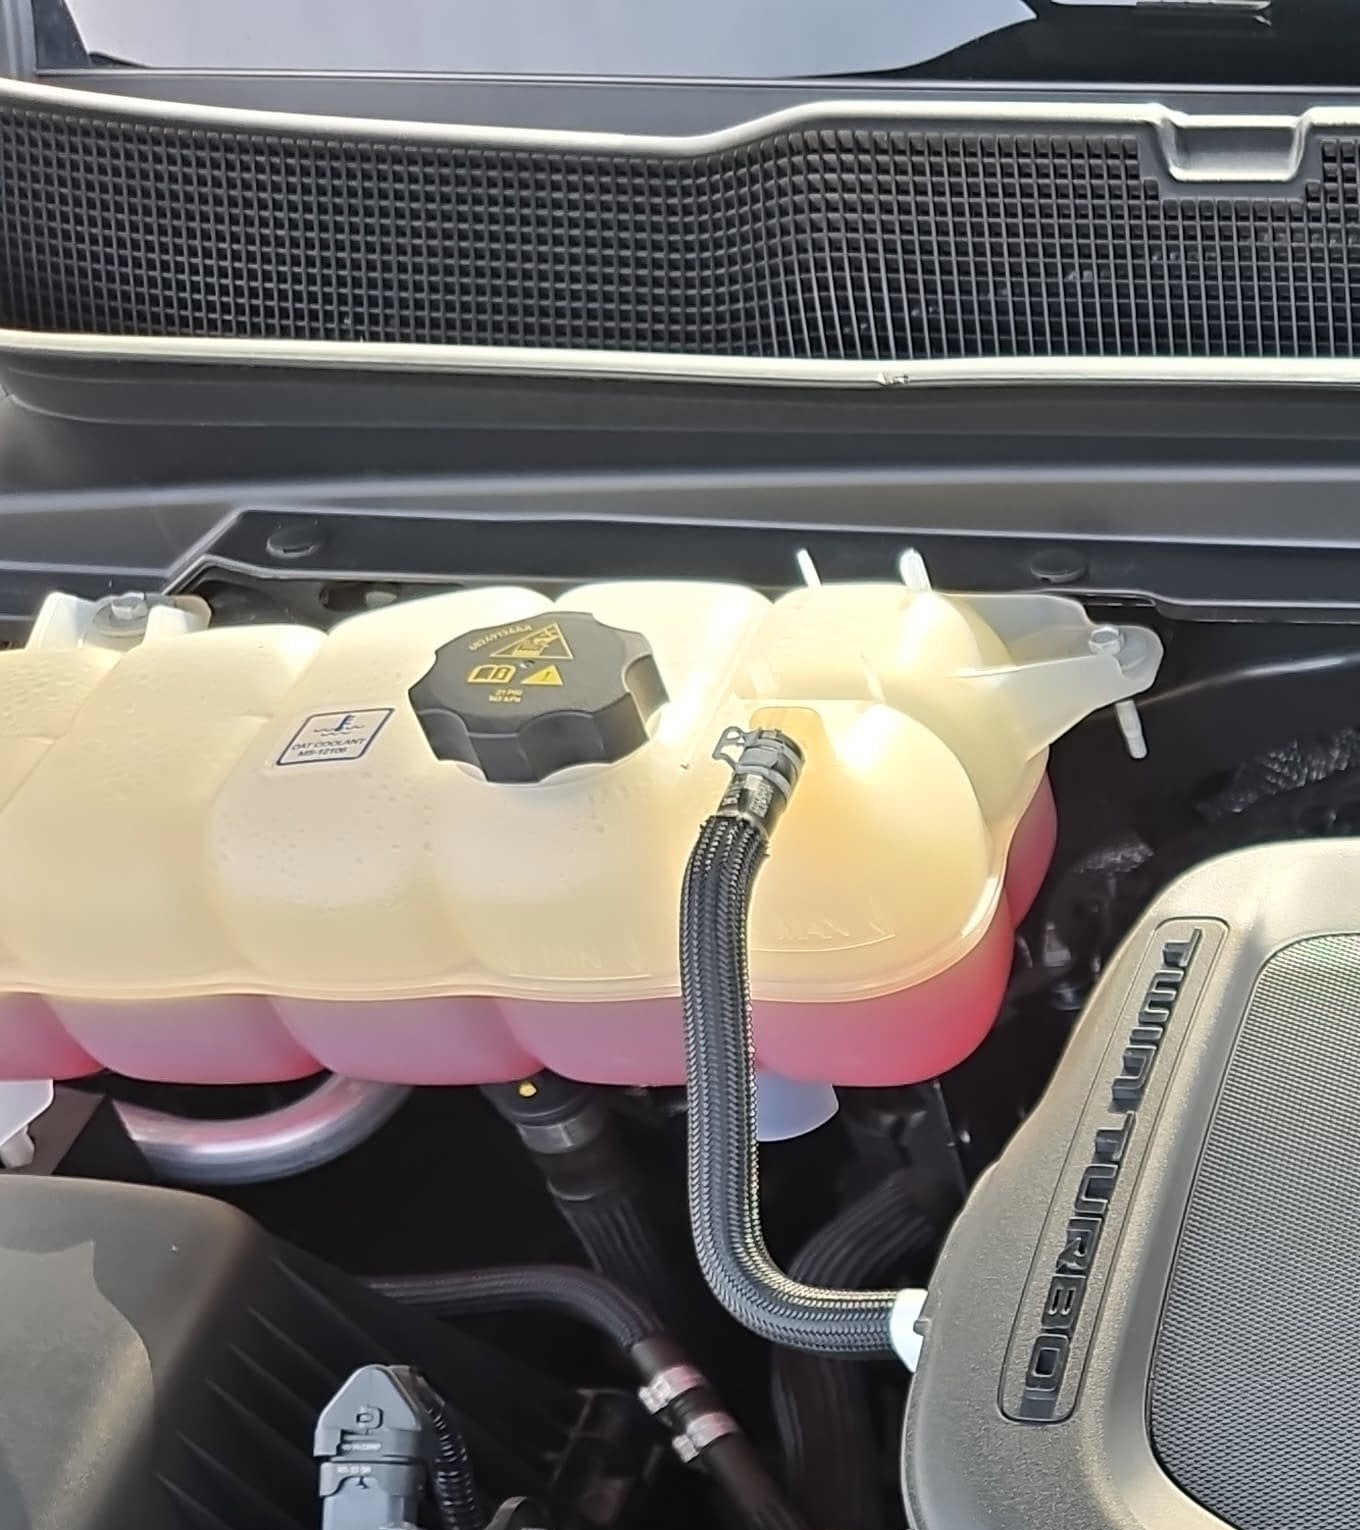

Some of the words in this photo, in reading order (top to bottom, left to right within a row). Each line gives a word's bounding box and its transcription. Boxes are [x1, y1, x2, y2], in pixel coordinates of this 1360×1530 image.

[315, 738, 366, 748] COOLANT
[1111, 928, 1203, 1105] TWIN
[1024, 1111, 1137, 1393] TURBO
